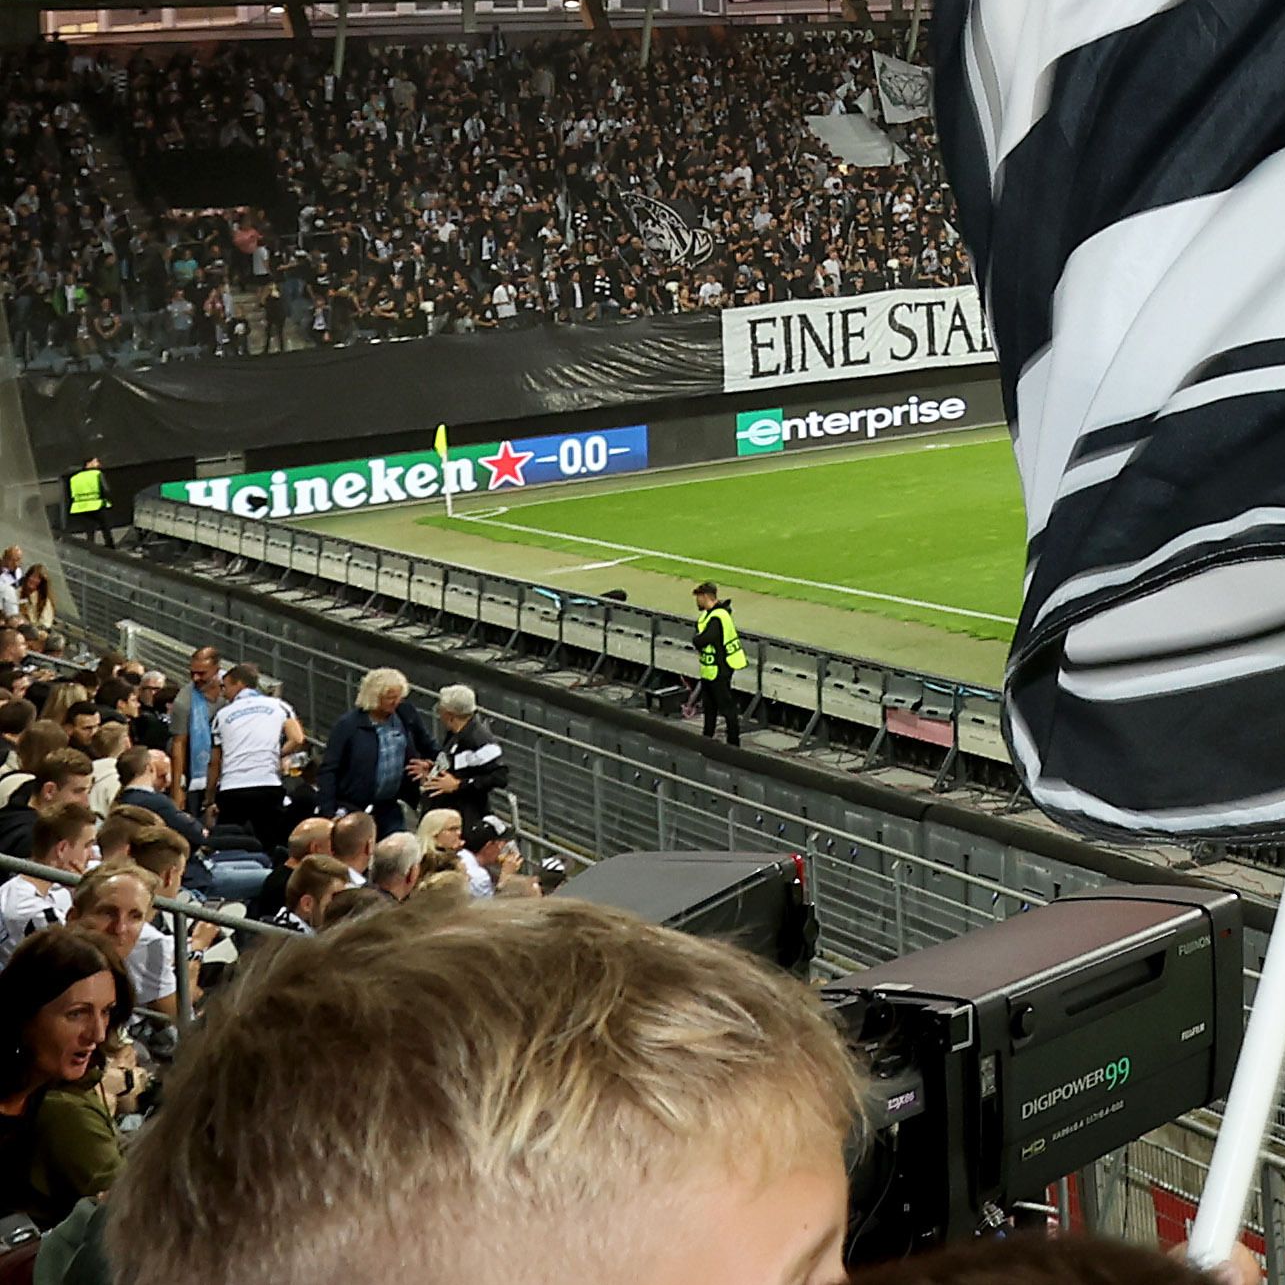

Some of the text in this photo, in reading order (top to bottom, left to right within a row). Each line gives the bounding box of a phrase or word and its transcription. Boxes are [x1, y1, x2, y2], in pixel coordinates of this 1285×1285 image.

[747, 306, 871, 379] EINE
[737, 395, 966, 446] enterprise
[184, 456, 477, 520] Heineken
